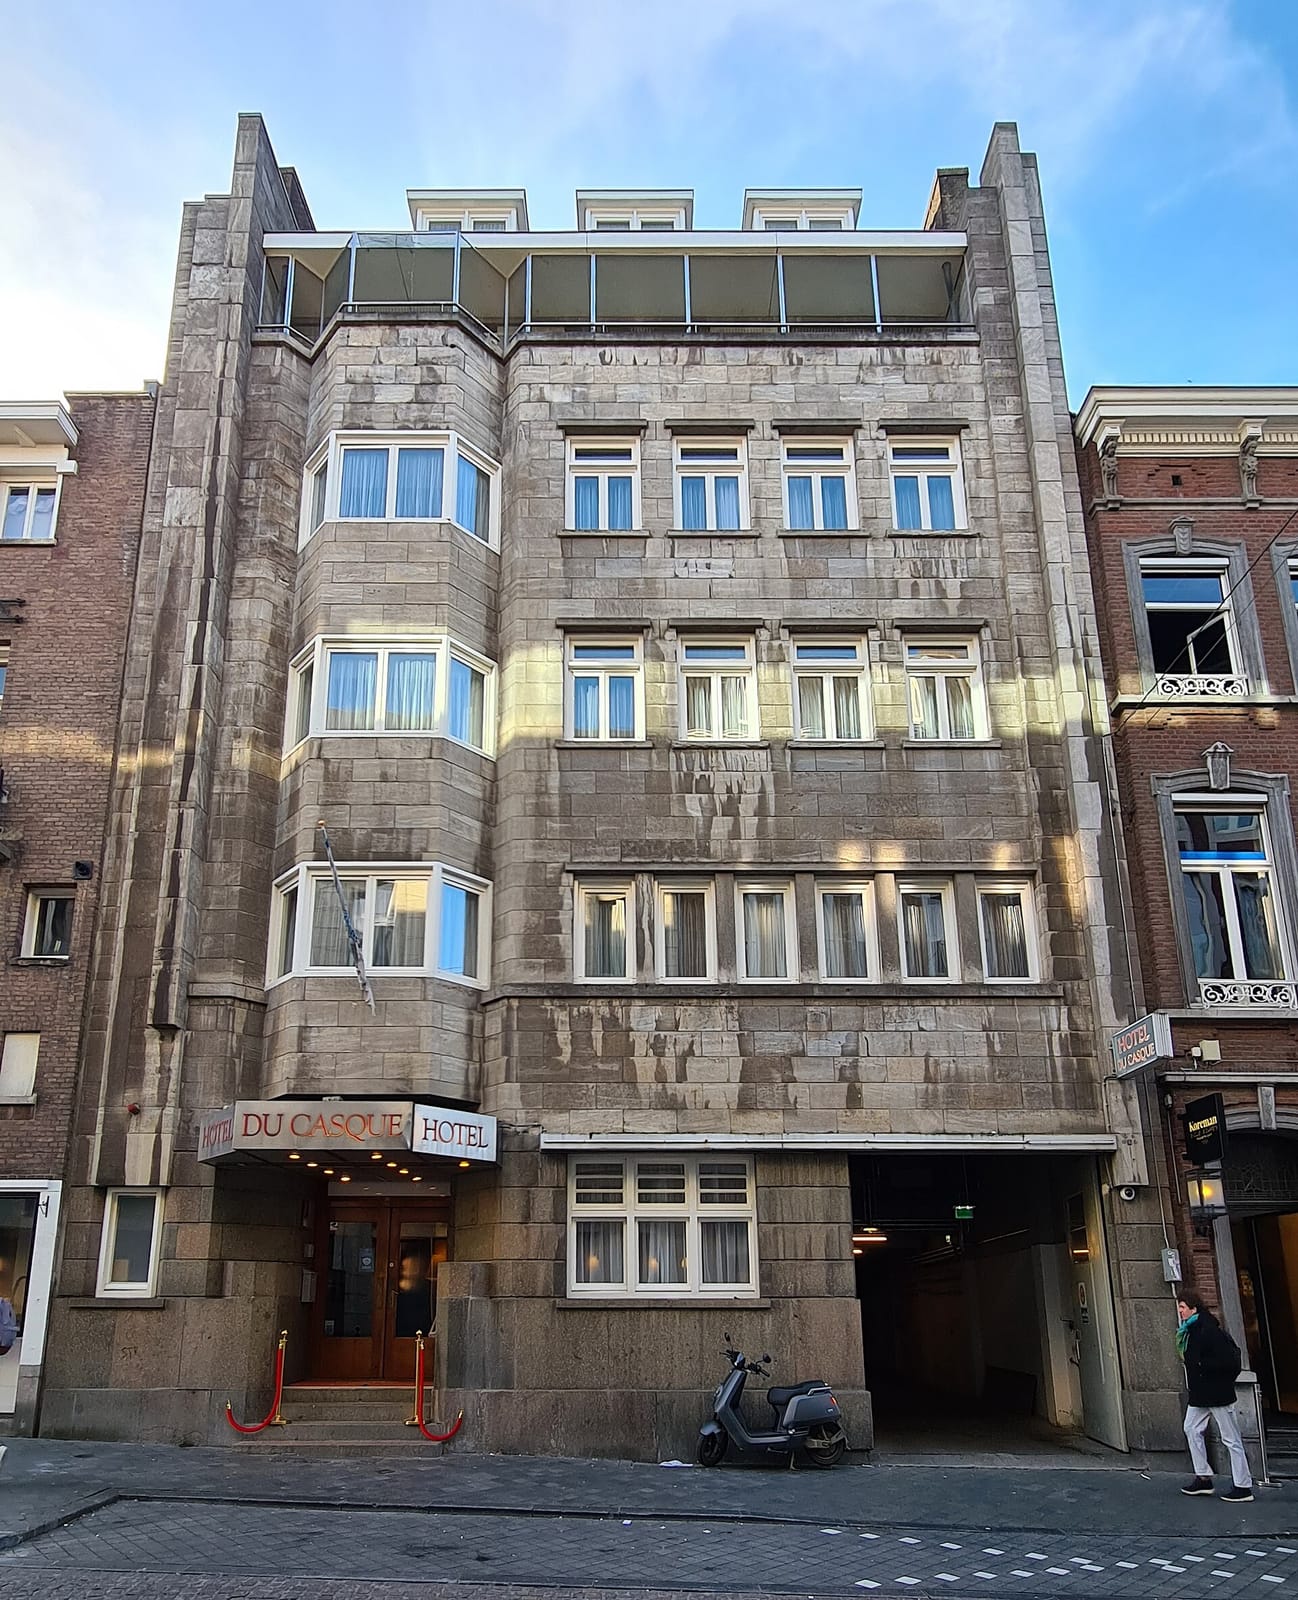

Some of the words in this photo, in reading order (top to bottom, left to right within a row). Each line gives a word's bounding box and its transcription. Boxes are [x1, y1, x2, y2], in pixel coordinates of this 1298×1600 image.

[1117, 1024, 1150, 1053] HOTEL
[1117, 1055, 1128, 1071] DU
[1127, 1043, 1155, 1065] CASQUE
[203, 1118, 233, 1147] HOTEL
[241, 1112, 285, 1137] DU
[289, 1112, 404, 1142] CASQUE
[421, 1117, 490, 1148] HOTEL
